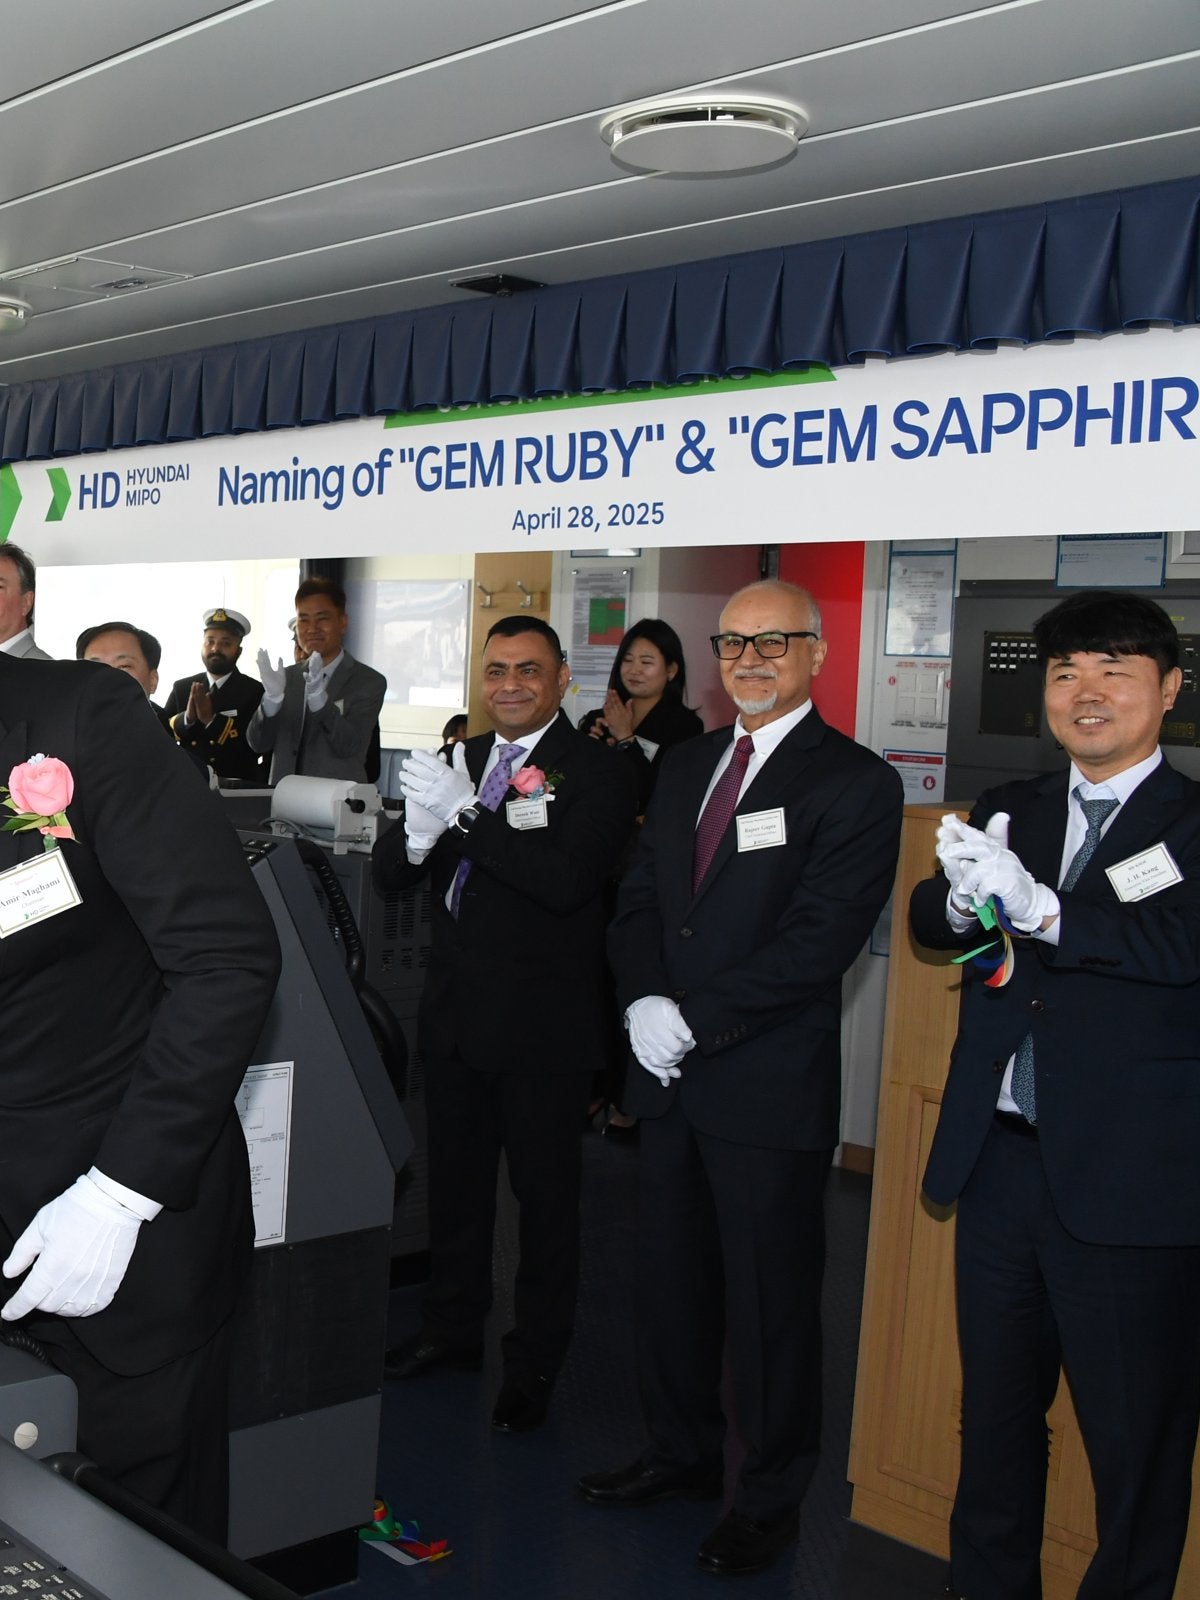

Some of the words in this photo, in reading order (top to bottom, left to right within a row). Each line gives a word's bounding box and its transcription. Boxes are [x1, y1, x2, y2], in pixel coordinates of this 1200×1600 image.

[218, 456, 345, 511] Naming
[352, 447, 394, 497] of
[400, 439, 505, 492] "GEM
[514, 423, 665, 488] RUBY"
[675, 419, 715, 475] &
[728, 404, 878, 469] "GEM
[126, 463, 190, 484] HYUNDAI
[79, 472, 121, 509] HD
[125, 487, 161, 507] MIPO
[513, 506, 561, 533] April
[568, 505, 600, 533] 28,
[608, 501, 665, 527] 2025
[0, 895, 21, 909] Amir
[21, 878, 61, 899] Maghami
